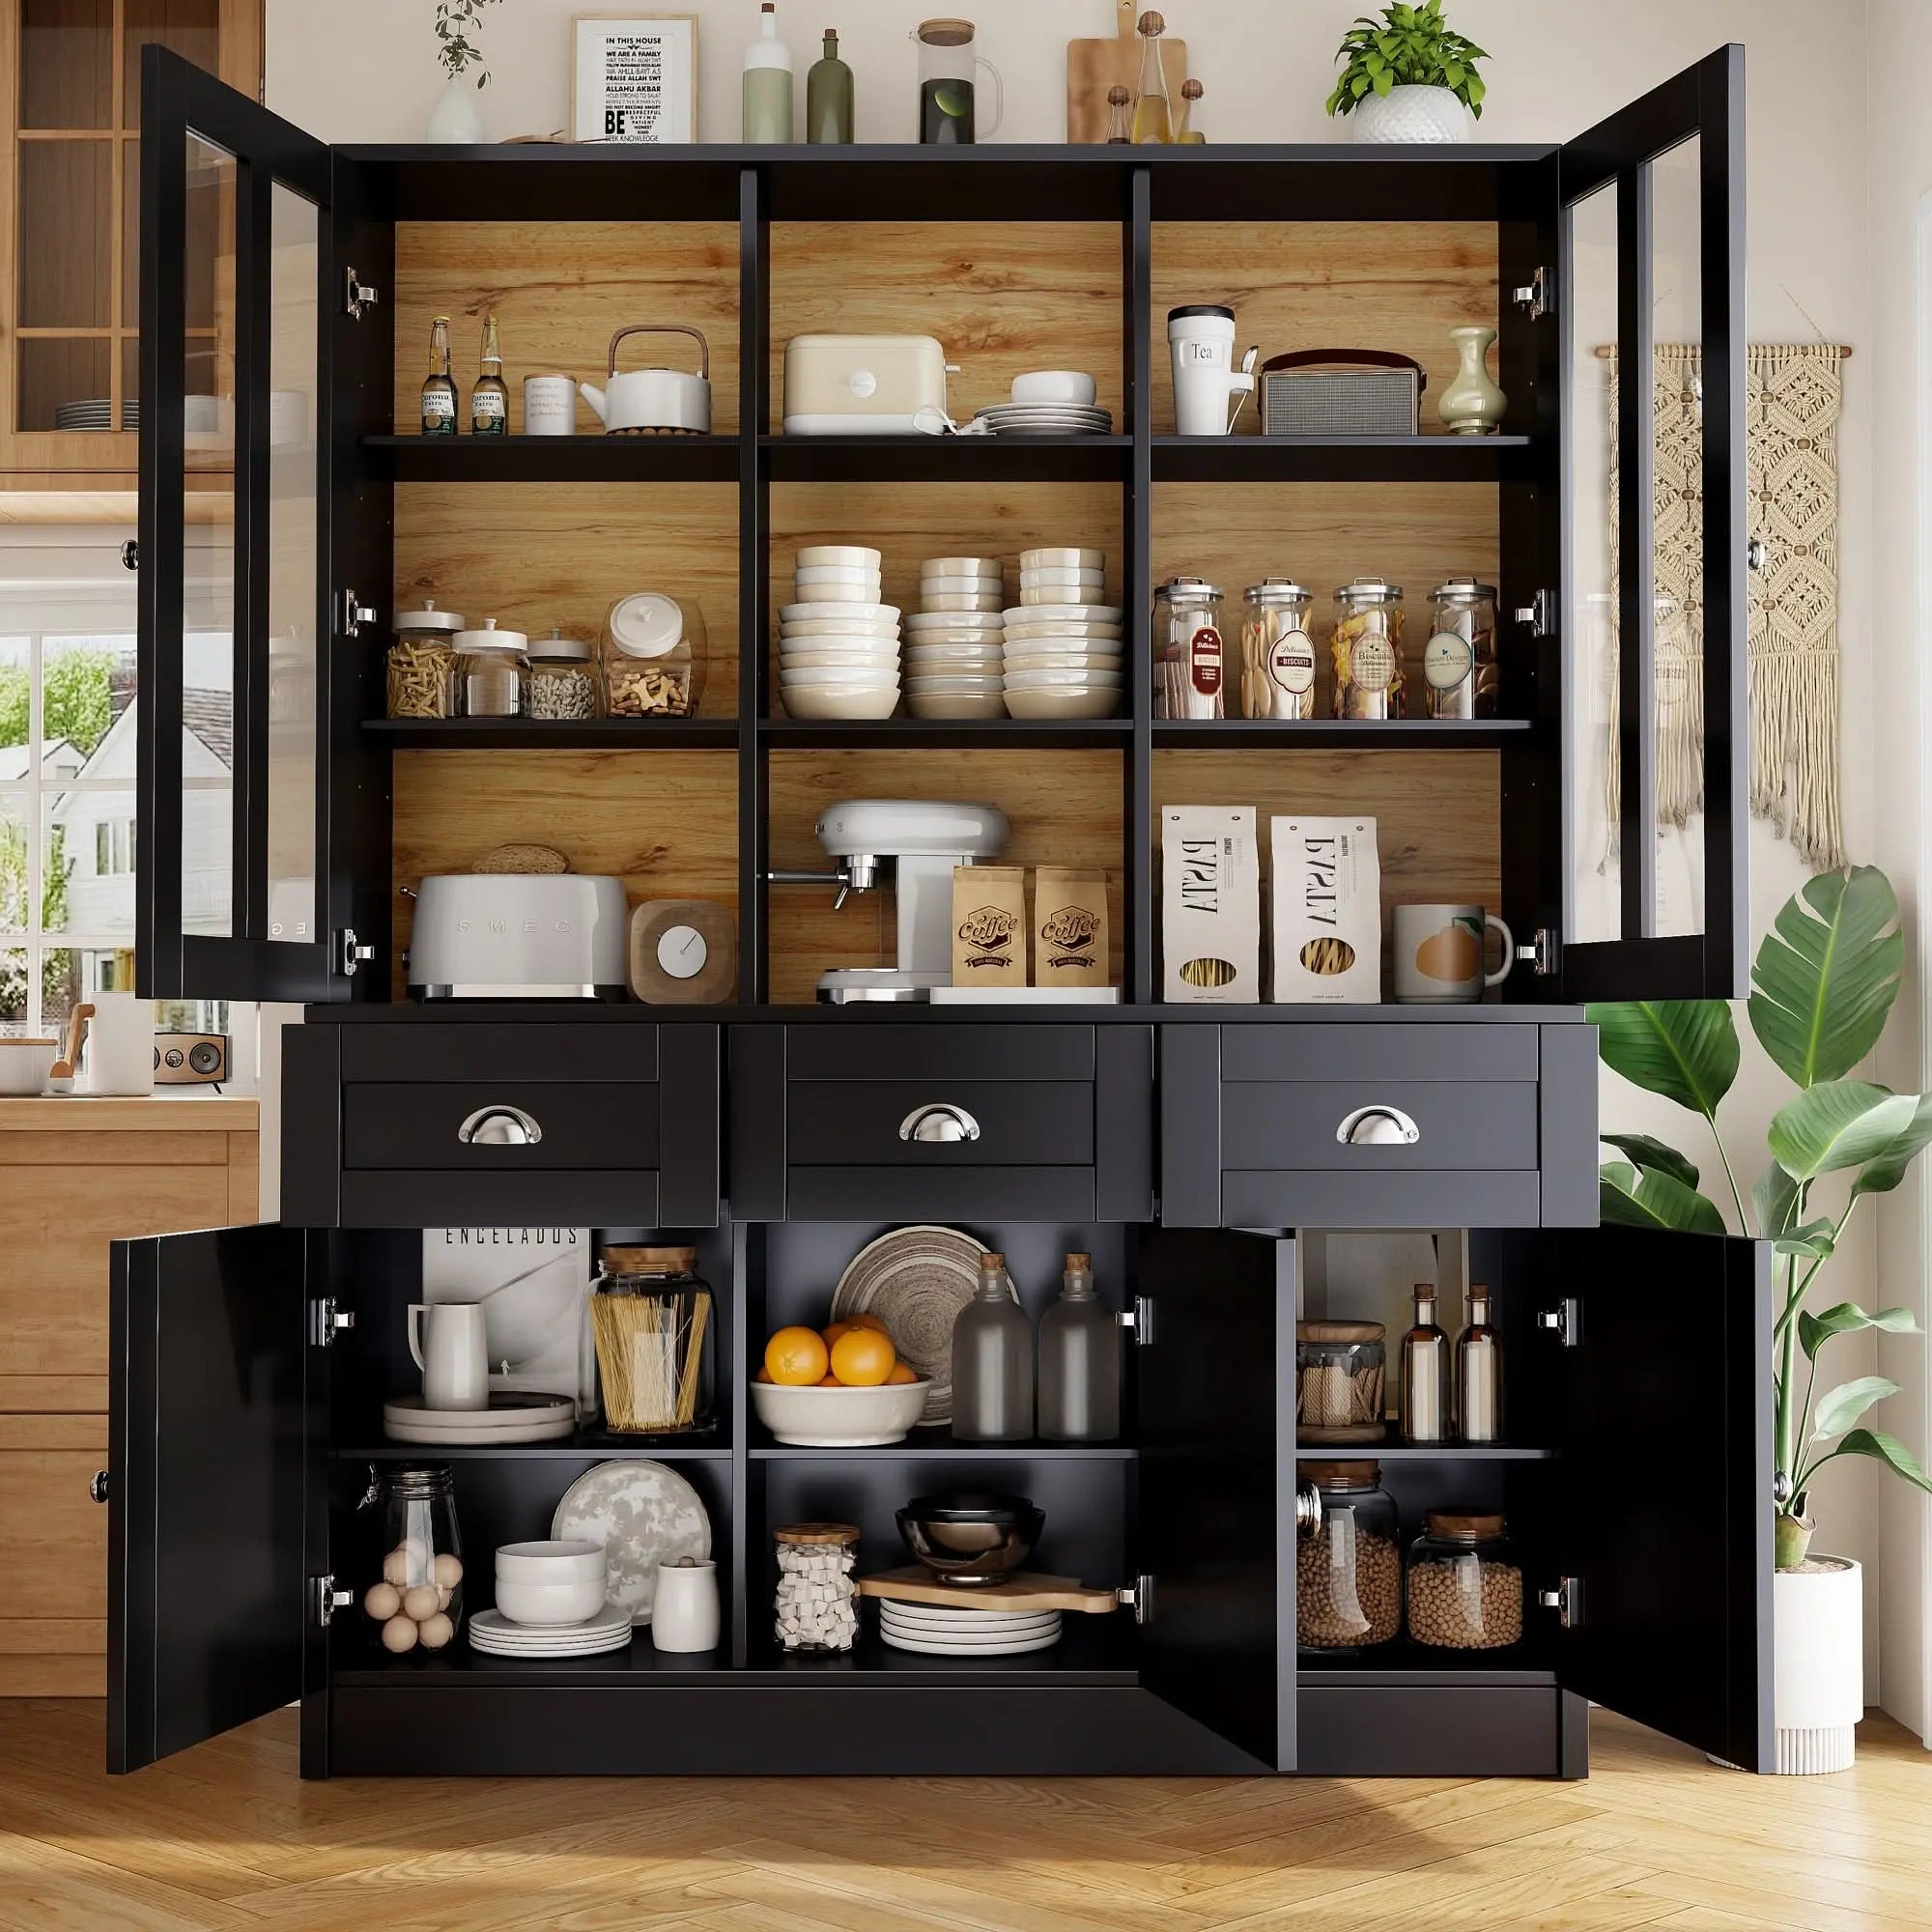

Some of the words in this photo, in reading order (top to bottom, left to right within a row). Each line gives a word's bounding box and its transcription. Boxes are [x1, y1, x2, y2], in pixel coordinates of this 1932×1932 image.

[605, 110, 626, 135] BE
[1191, 343, 1213, 359] Tea
[957, 915, 1018, 941] Coffee
[1040, 915, 1101, 941] Coffee
